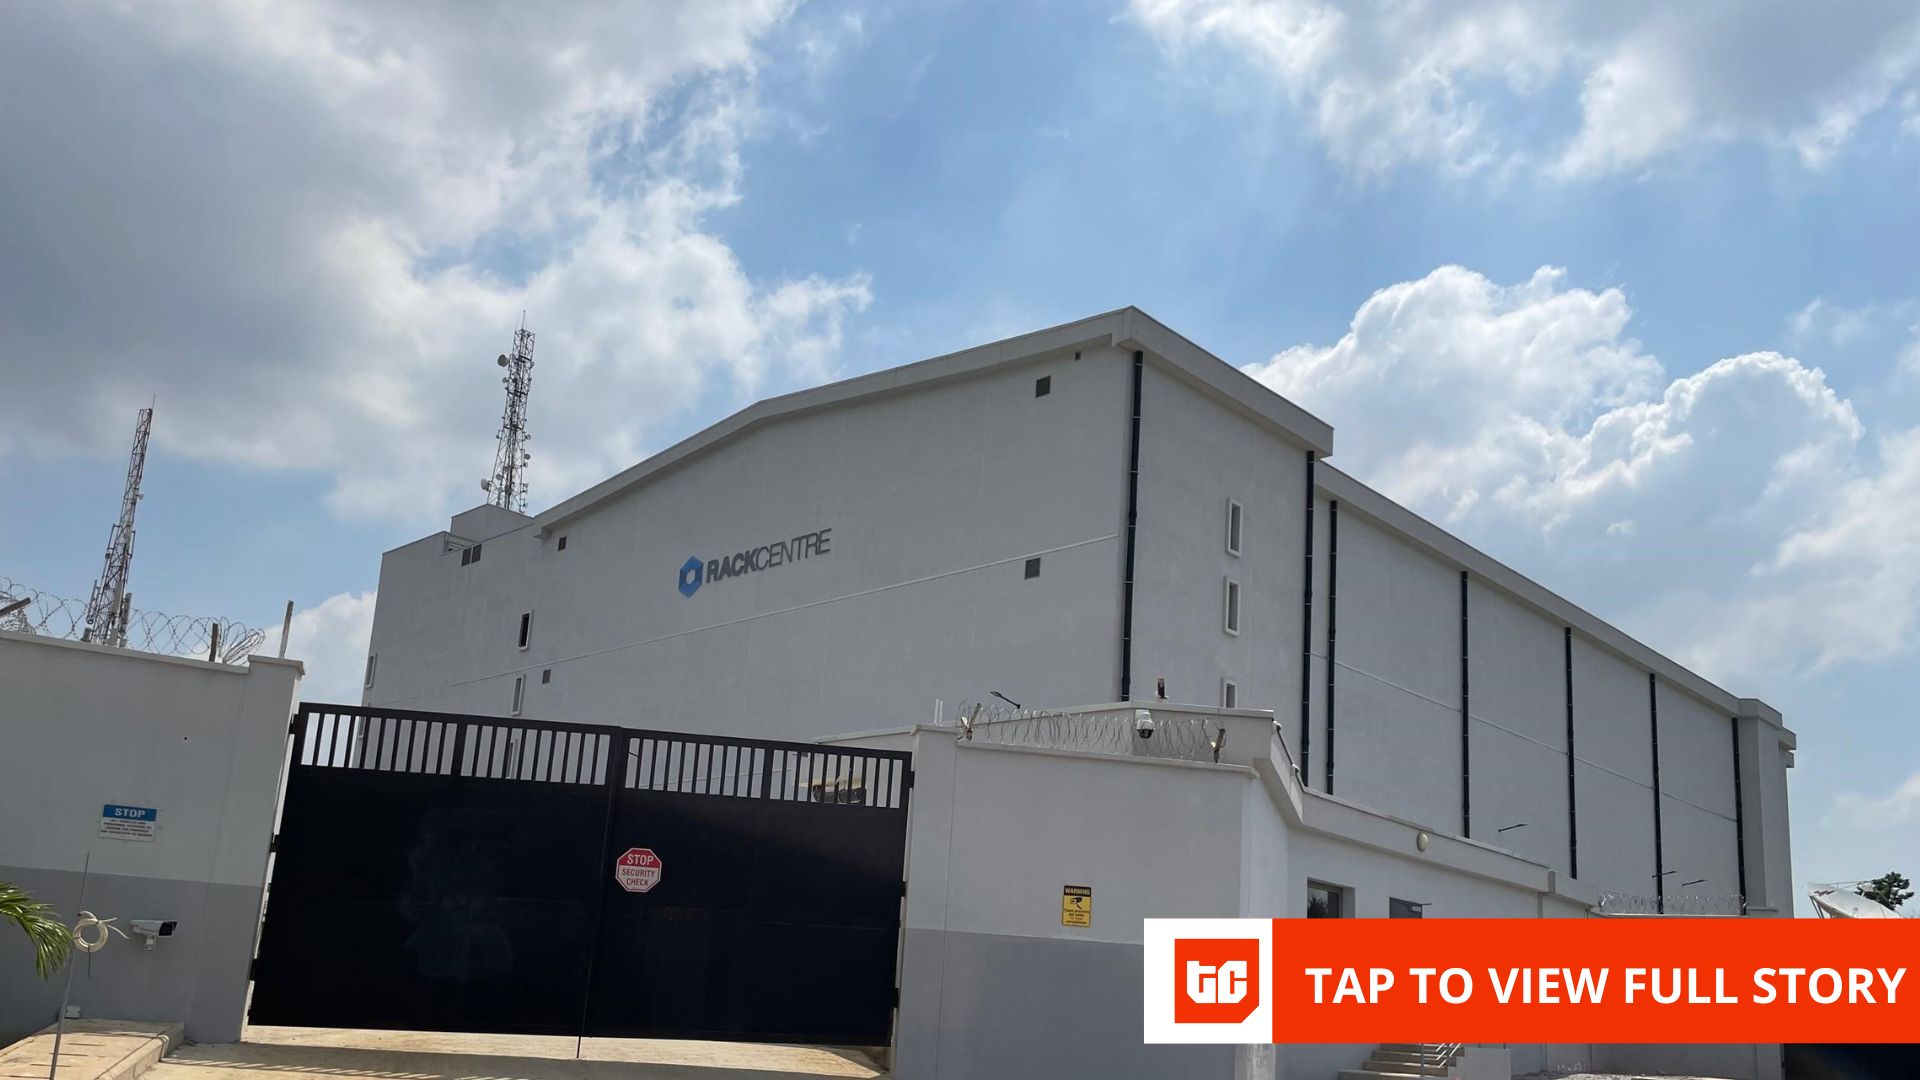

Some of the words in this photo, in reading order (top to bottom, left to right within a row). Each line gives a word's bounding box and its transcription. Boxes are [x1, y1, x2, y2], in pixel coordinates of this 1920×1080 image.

[706, 528, 832, 583] RACKCENTRE
[114, 808, 146, 818] STOP
[627, 853, 654, 866] STOP
[622, 868, 656, 878] SECURITY
[626, 878, 649, 887] CHECK
